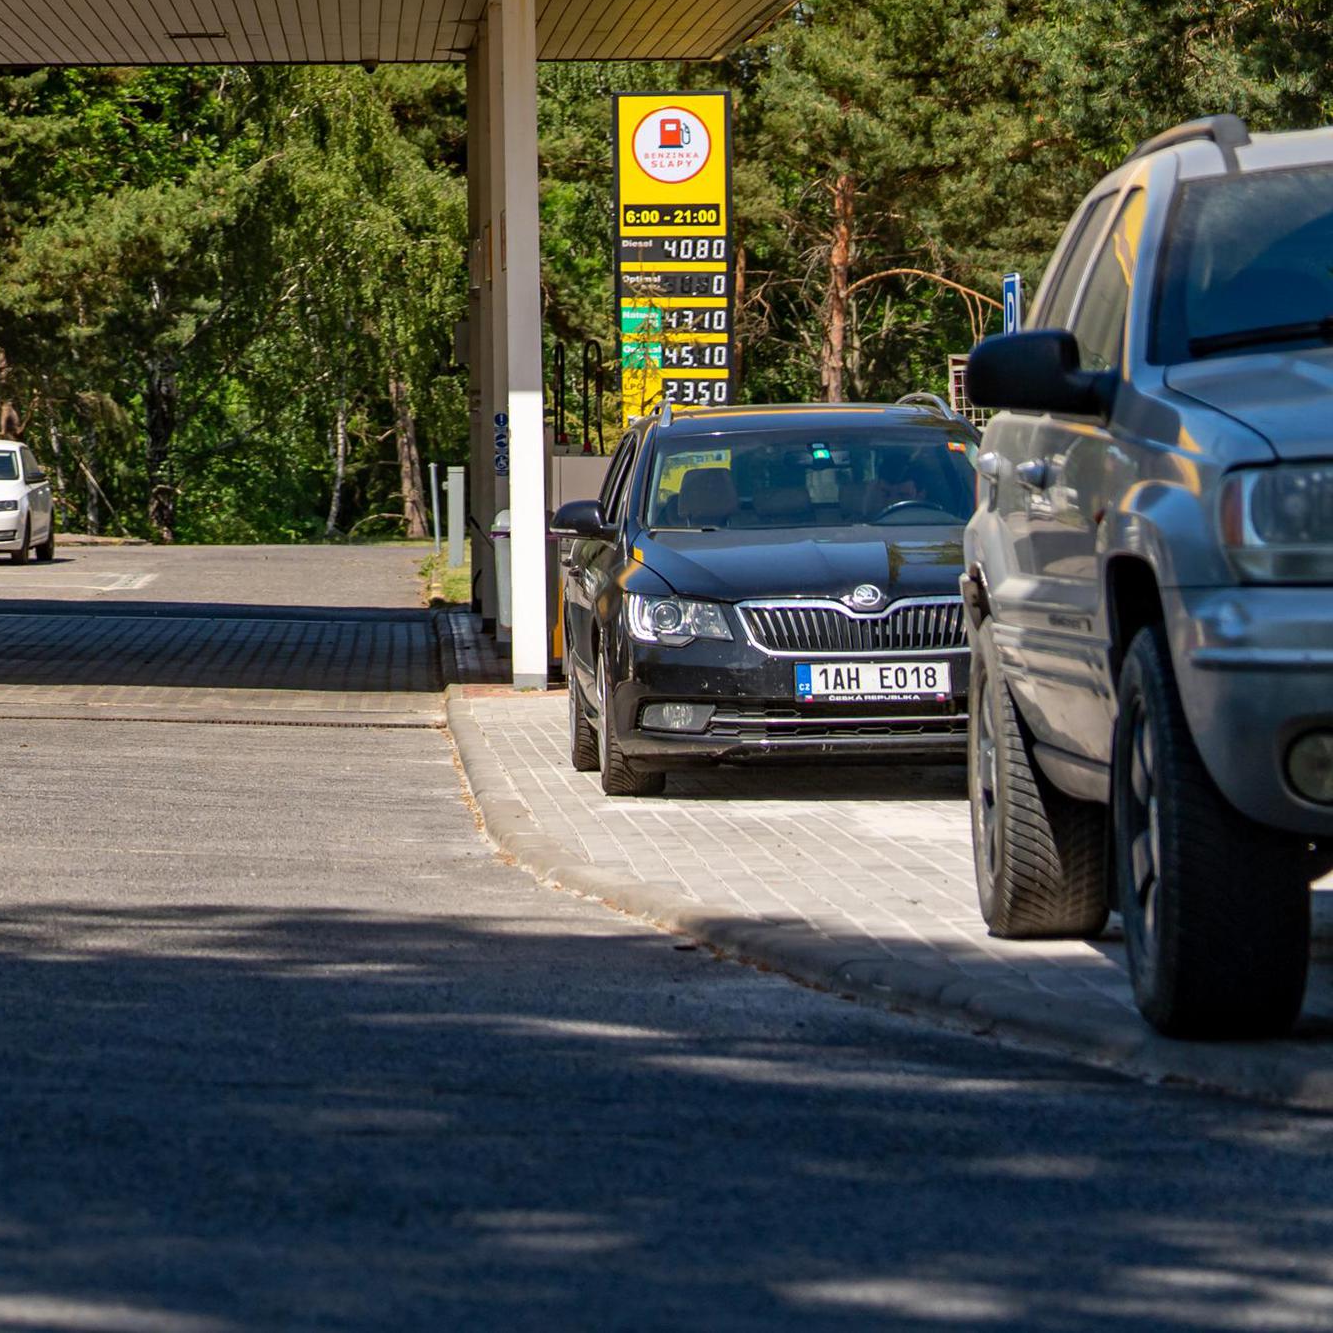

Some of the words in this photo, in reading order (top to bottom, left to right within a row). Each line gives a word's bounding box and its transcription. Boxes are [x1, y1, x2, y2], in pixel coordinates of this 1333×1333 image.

[651, 160, 692, 168] SLAPY
[626, 210, 660, 223] 6:00
[674, 210, 717, 223] 21:00
[622, 239, 653, 247] Diesel
[663, 239, 725, 260] 40.80
[664, 346, 726, 367] 45.10
[666, 381, 727, 403] 23.50
[819, 668, 861, 690] 1AH
[879, 667, 937, 689] E018
